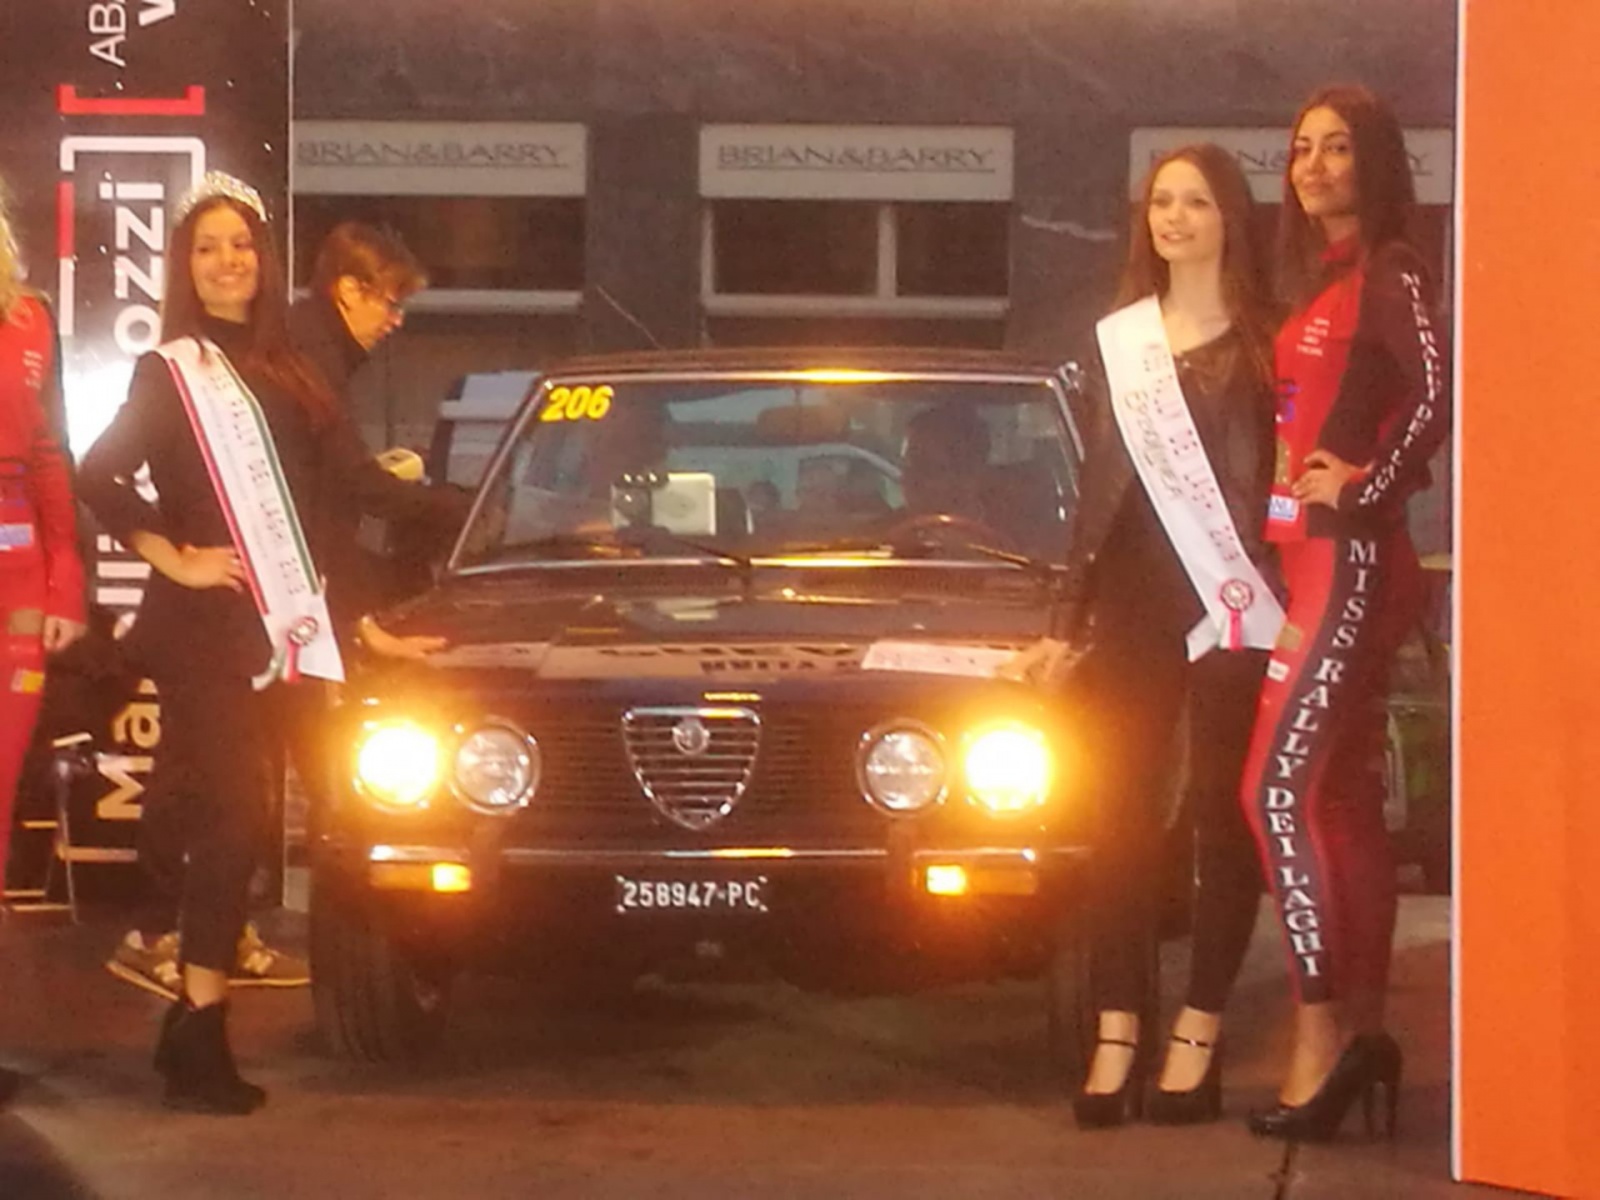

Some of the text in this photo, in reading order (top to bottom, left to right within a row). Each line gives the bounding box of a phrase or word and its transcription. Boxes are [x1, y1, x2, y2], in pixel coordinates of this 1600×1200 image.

[89, 0, 126, 67] AB
[718, 144, 993, 168] BRIAN&BARRY
[541, 385, 615, 422] 206
[1332, 539, 1378, 648] MISS
[1277, 656, 1344, 778] RALLY
[1265, 786, 1295, 858] DEI
[1281, 866, 1324, 977] LAGHI
